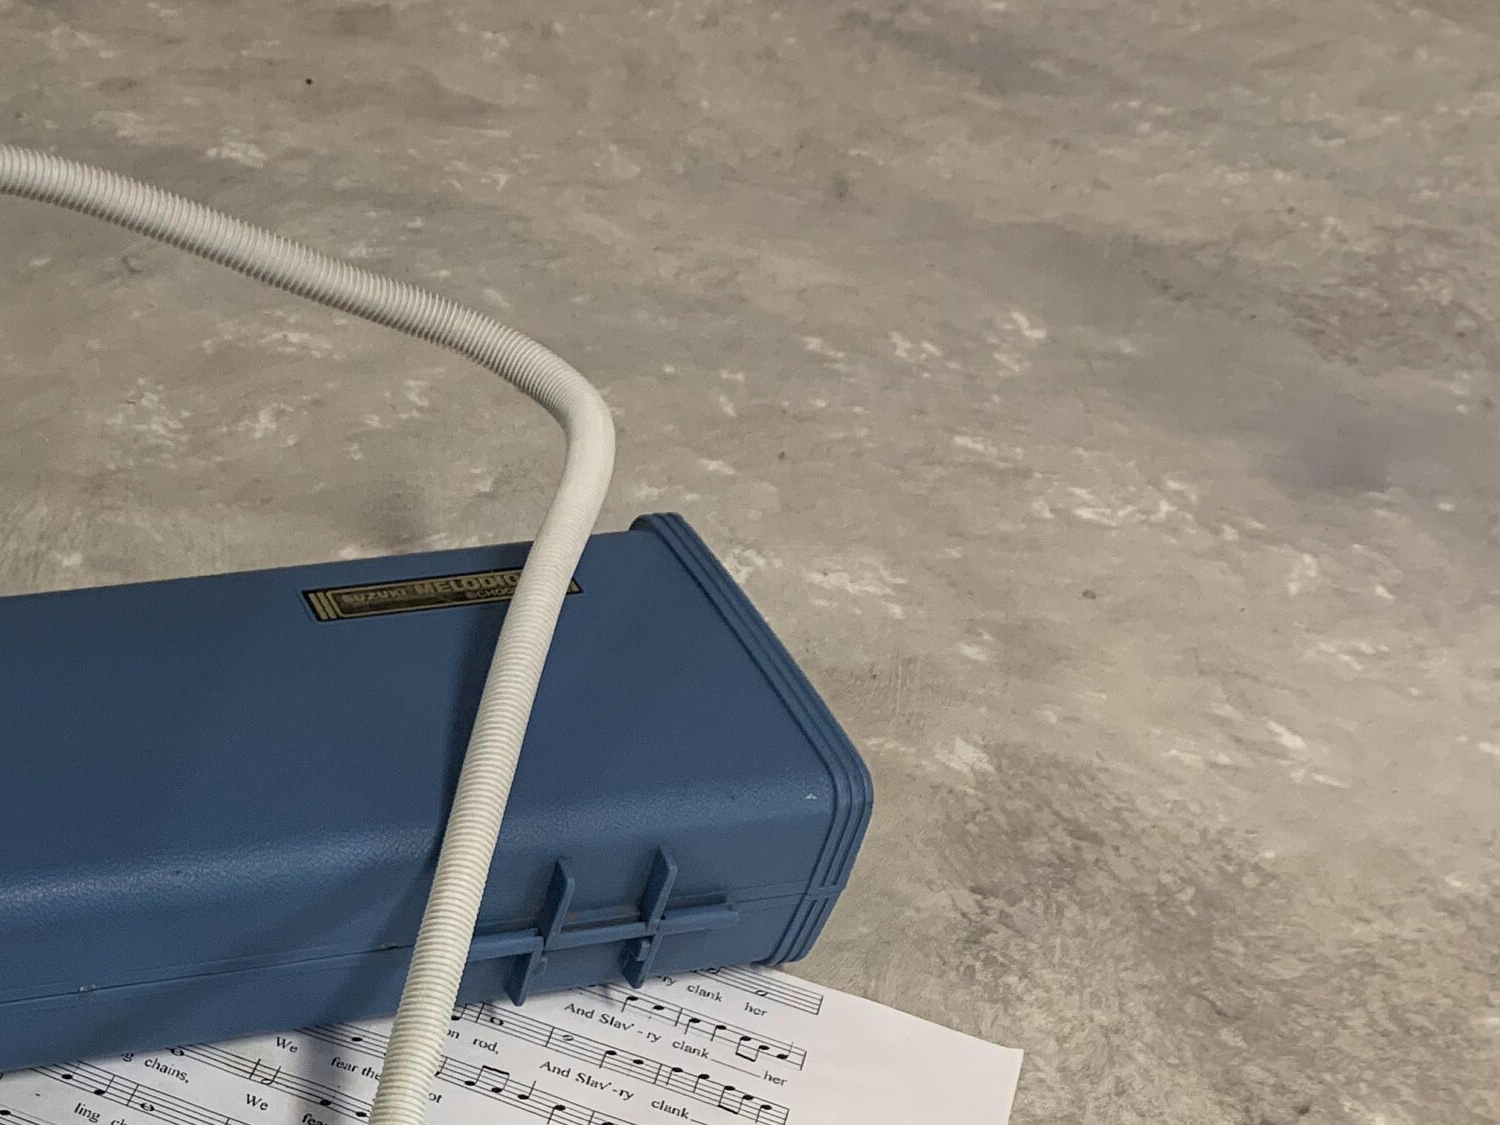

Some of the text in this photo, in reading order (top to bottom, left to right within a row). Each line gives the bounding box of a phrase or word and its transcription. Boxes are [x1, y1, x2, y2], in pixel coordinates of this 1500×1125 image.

[414, 574, 519, 595] MELODIO
[686, 984, 723, 1003] clank
[743, 1001, 768, 1017] her
[276, 1036, 298, 1053] We
[330, 1056, 359, 1073] fear
[563, 1002, 596, 1020] And
[671, 1040, 710, 1060] clank
[762, 1070, 788, 1087] her
[143, 1057, 189, 1084] chains,
[246, 1093, 269, 1111] We
[472, 1037, 499, 1056] rod,
[539, 1060, 572, 1079] And
[650, 1099, 690, 1120] clank
[73, 1102, 101, 1124] ling
